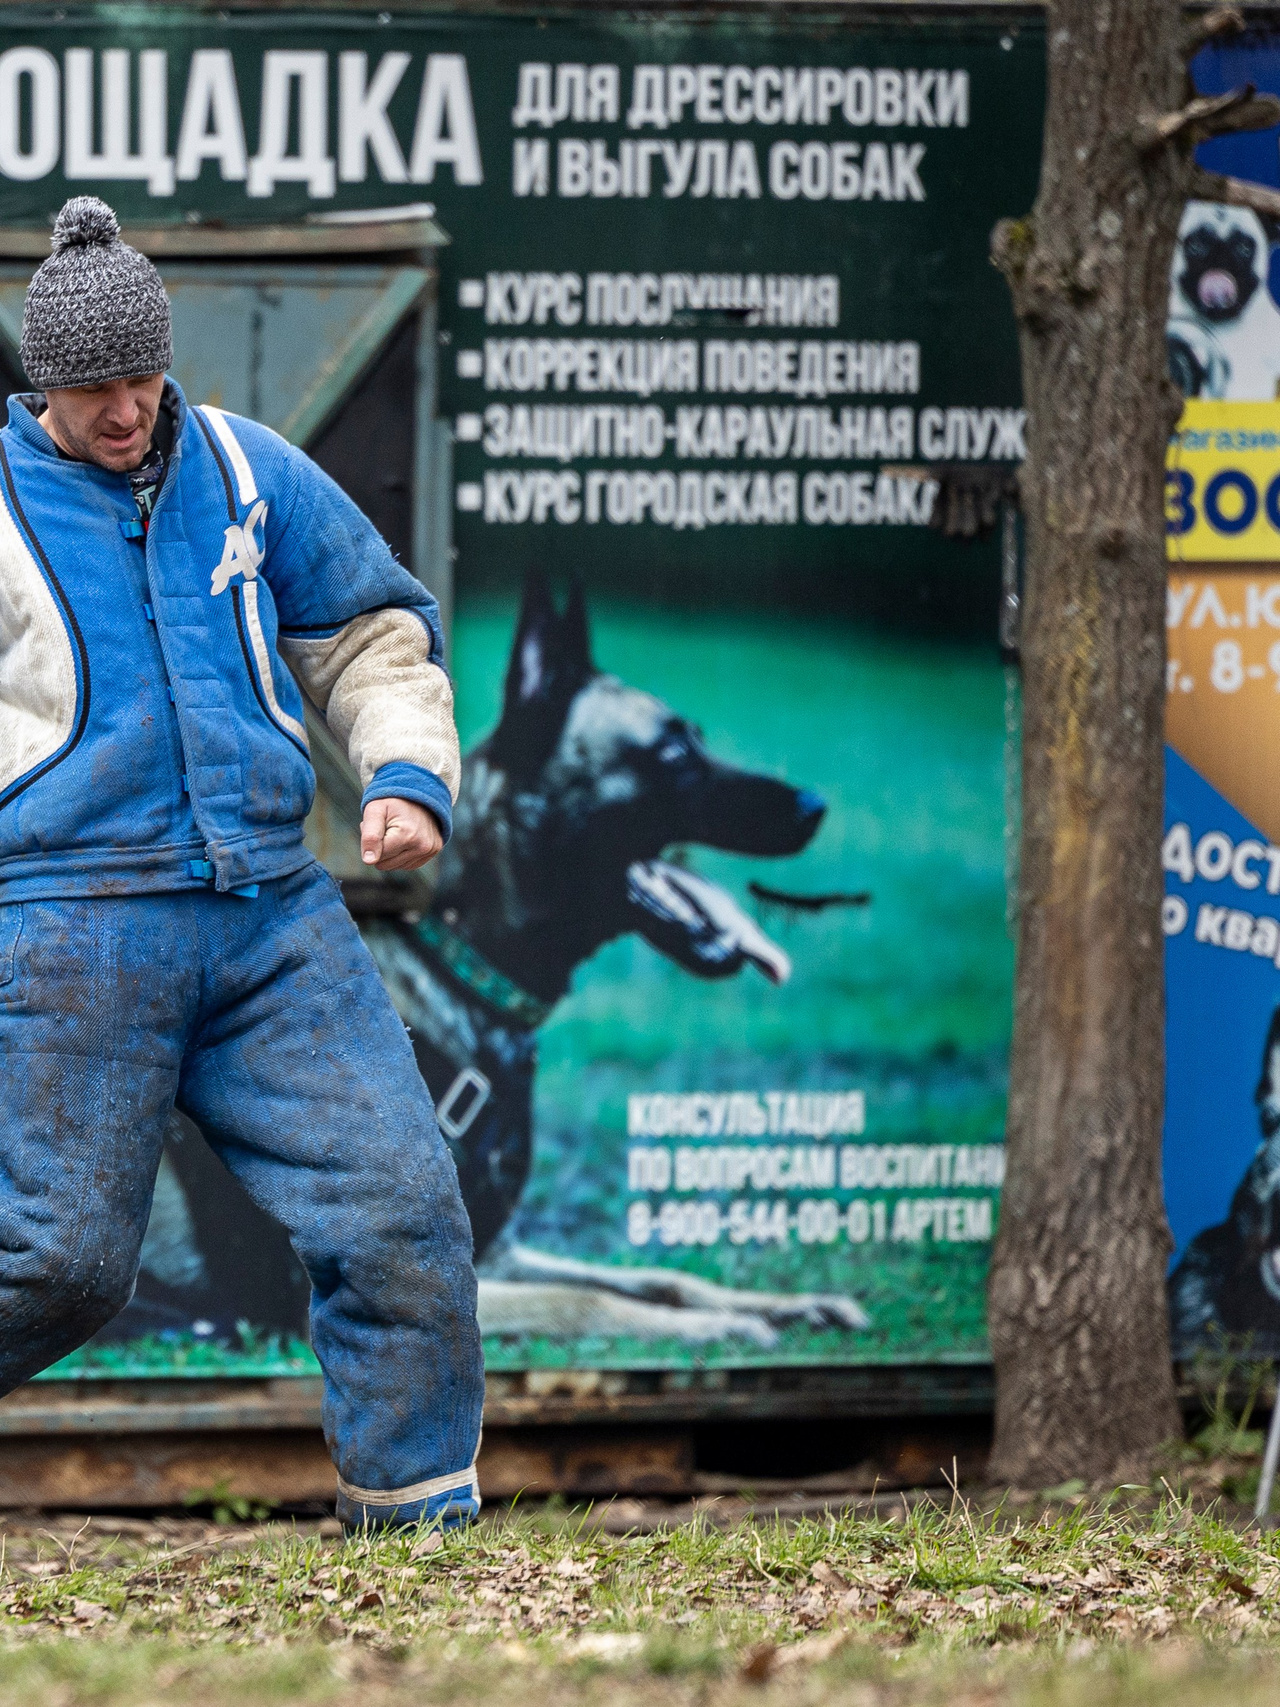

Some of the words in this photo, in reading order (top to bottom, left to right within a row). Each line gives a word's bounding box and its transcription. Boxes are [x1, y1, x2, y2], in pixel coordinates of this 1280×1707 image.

[512, 63, 619, 128] ДЛЯ
[627, 64, 970, 129] ДРЕССИРОВКИ
[513, 138, 549, 197] И
[558, 138, 761, 200] ВЫГУЛА
[769, 141, 926, 201] СОБАК
[485, 272, 582, 326] КУРС
[484, 338, 698, 396] КОРРЕКЦИЯ
[703, 340, 920, 398] ПОВЕДЕНИЯ
[483, 404, 914, 462] ЗАЩИТНО-КАРАУЛЬНАЯ
[919, 405, 1027, 460] СЛУЖ
[484, 470, 581, 524] КУРС
[586, 471, 799, 530] ГОРОДСКАЯ
[627, 1090, 866, 1139] КОНСУЛЬТАЦИЯ
[627, 1146, 672, 1192] ПО
[675, 1144, 836, 1191] ВОПРОСАМ
[627, 1199, 887, 1246] 8-900-544-00-01
[891, 1197, 992, 1242] АРТЕМ
